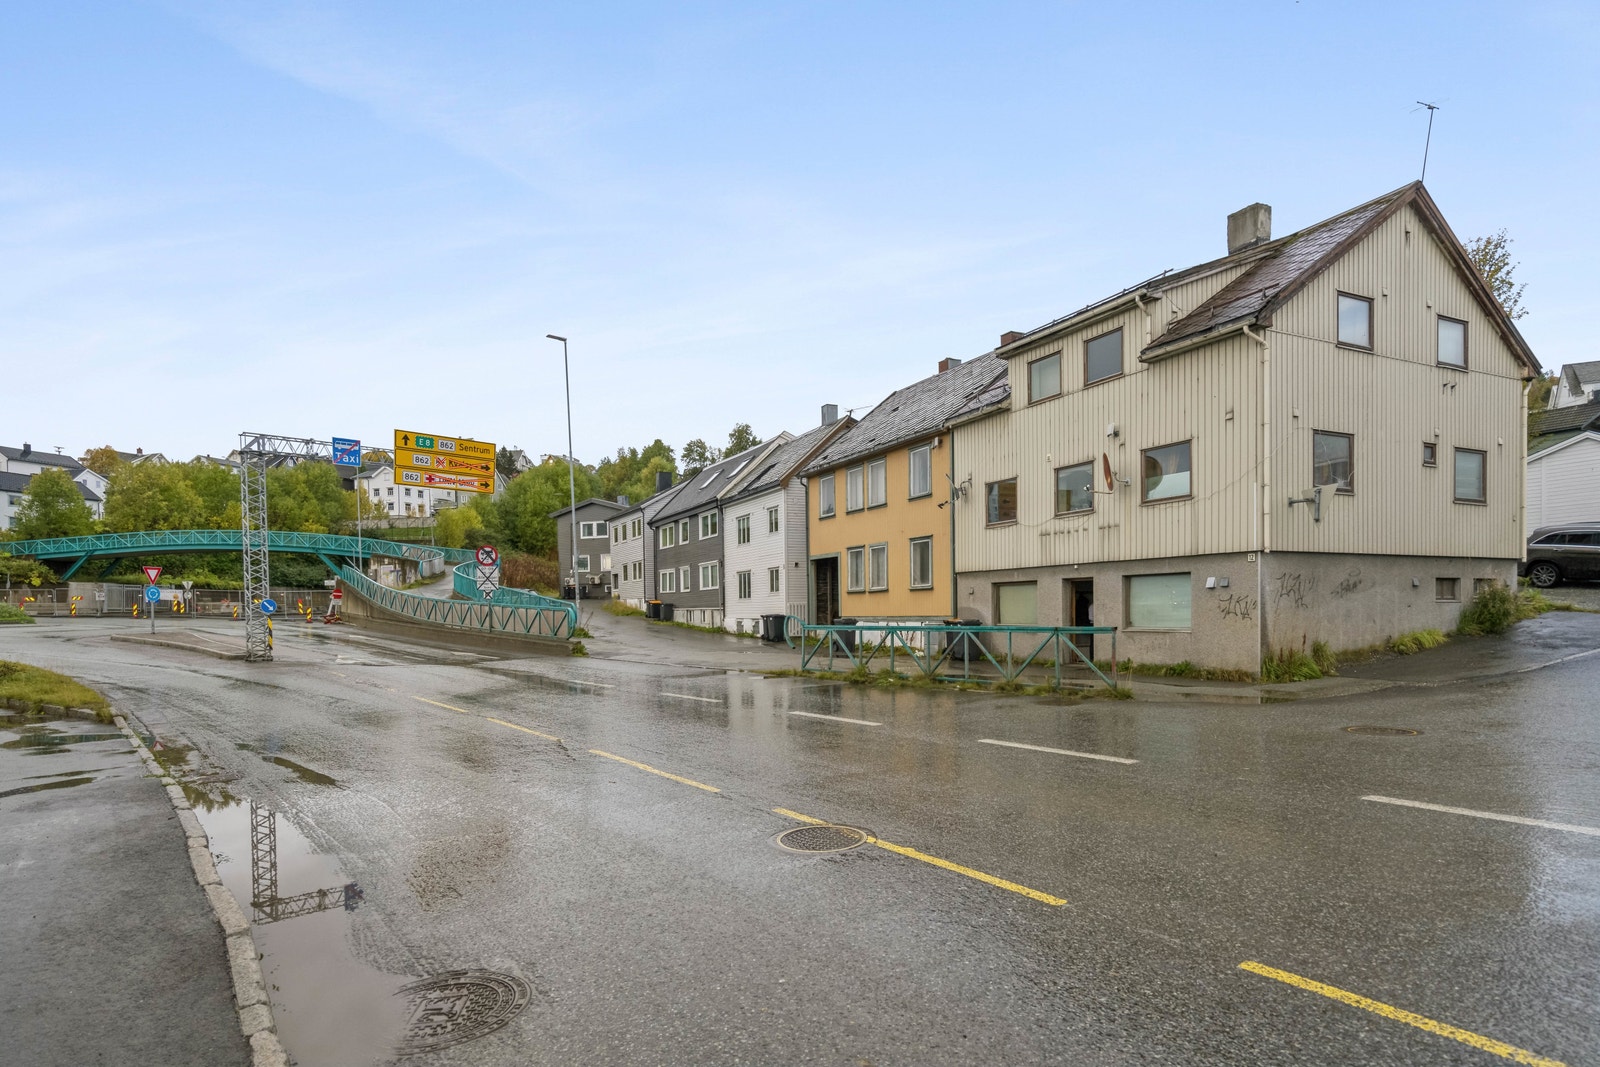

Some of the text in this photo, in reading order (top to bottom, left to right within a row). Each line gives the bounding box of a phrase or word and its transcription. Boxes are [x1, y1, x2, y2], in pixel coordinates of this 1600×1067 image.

[419, 438, 491, 455] E 8 862 Sentrum
[335, 451, 359, 464] Taxi
[414, 456, 430, 465] 862
[404, 472, 420, 482] 862
